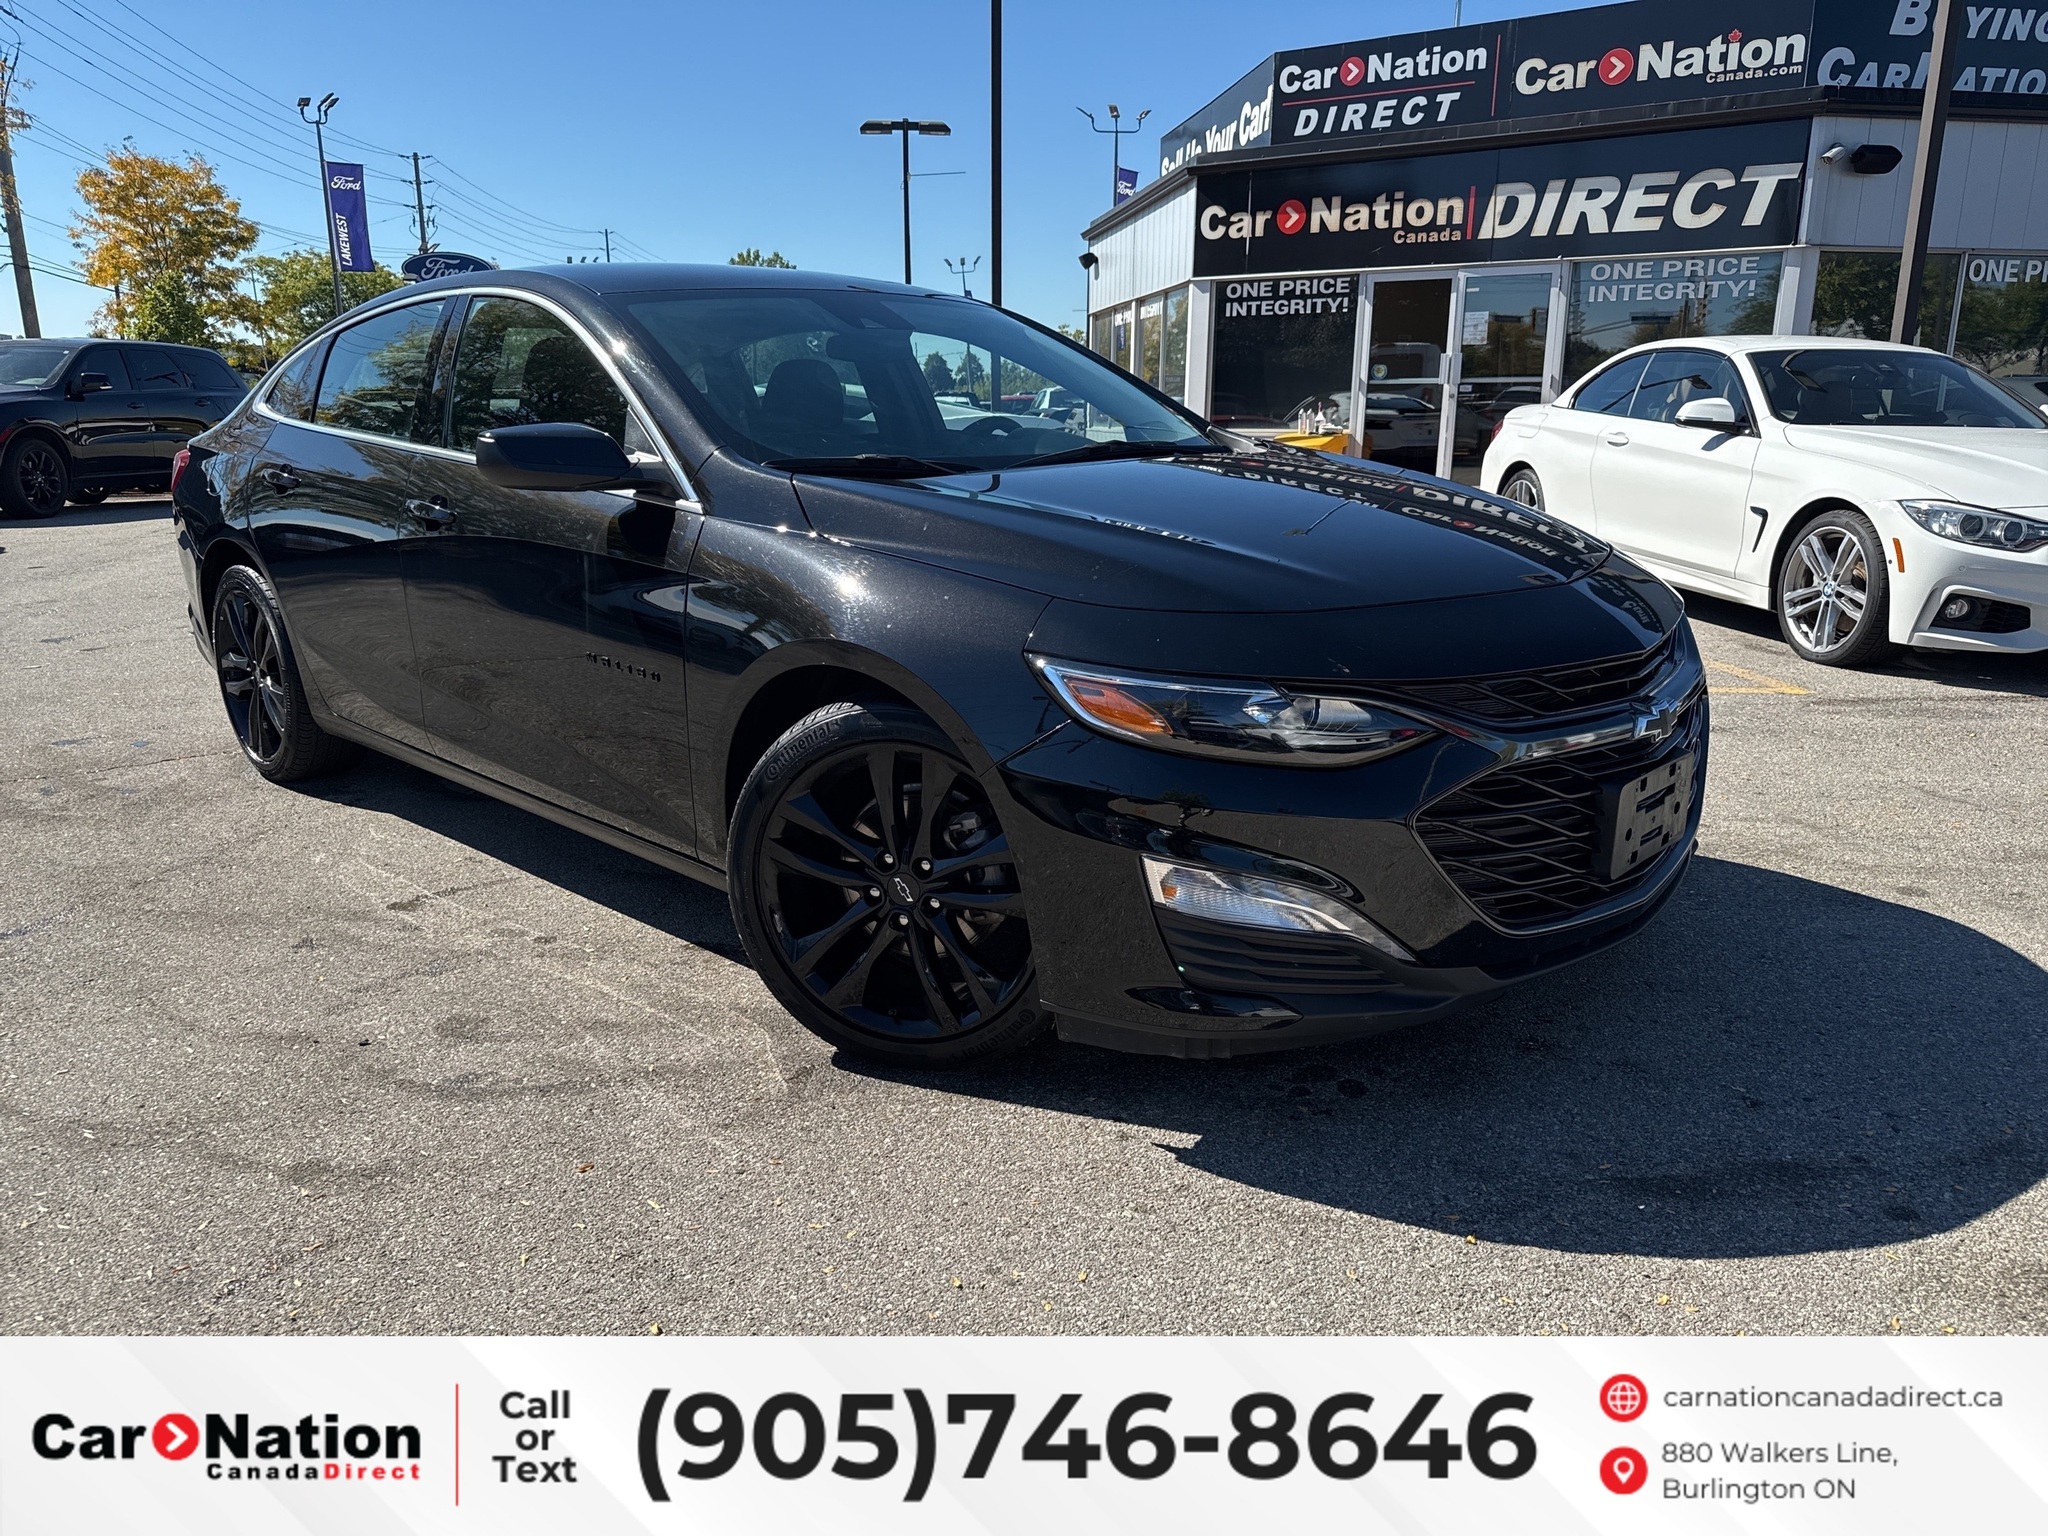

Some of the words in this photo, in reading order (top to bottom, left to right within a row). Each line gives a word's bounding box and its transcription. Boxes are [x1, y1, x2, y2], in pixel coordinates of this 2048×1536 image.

[1279, 65, 1338, 94] Car
[1367, 46, 1487, 84] Nation
[1515, 57, 1597, 95] Car
[1636, 33, 1806, 81] Nation
[1706, 64, 1802, 83] Canada.com
[1293, 92, 1461, 137] DIRECT
[330, 175, 362, 191] Ford
[1200, 204, 1273, 240] Car
[1310, 191, 1465, 233] Nation
[1477, 162, 1804, 240] DIRECT
[335, 213, 353, 266] LAKEWEST
[1393, 228, 1461, 244] Canada
[1590, 261, 1654, 281] ONE
[1662, 256, 1760, 278] PRICE
[1968, 258, 2020, 282] ONE
[1226, 281, 1273, 299] ONE
[1279, 277, 1351, 296] PRICE
[1588, 279, 1756, 303] INTEGRITY!
[1225, 297, 1348, 317] INTEGRITY!
